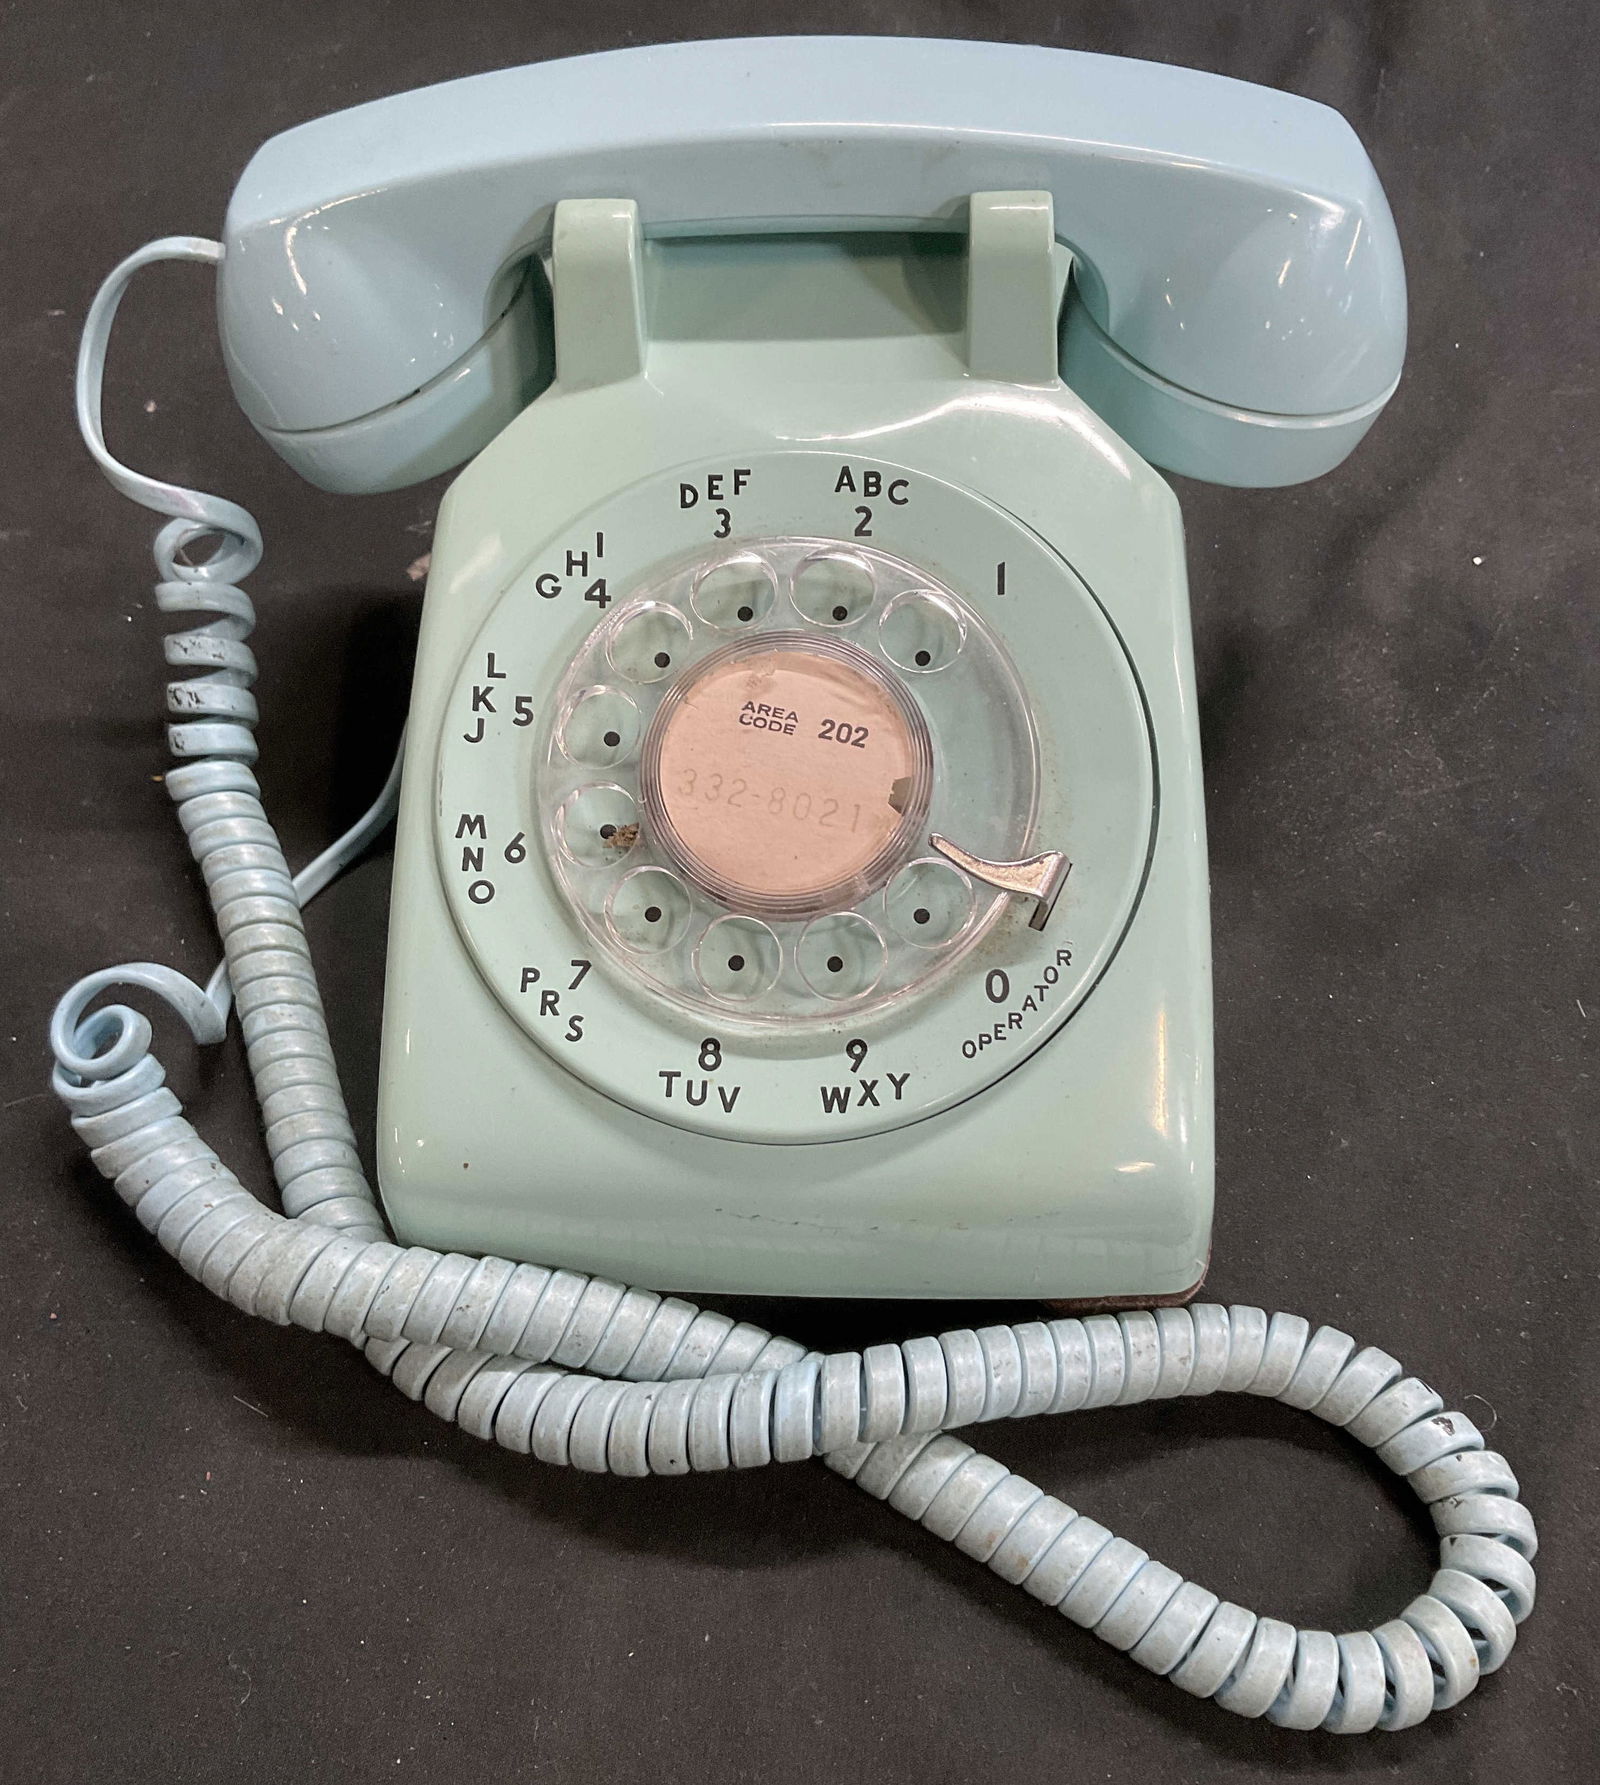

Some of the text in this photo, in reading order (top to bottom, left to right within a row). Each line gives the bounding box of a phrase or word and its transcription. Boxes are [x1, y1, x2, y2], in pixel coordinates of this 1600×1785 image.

[680, 469, 751, 509] DEF
[834, 466, 910, 505] ABC
[713, 508, 732, 538] 3
[854, 506, 873, 537] 2
[535, 532, 604, 599] GHI
[997, 561, 1005, 595] 1
[584, 578, 611, 608] 4
[512, 696, 534, 726] 5
[739, 713, 797, 735] CODE
[741, 701, 799, 723] AREA
[818, 719, 869, 748] 202
[677, 768, 861, 832] 332-8021
[504, 831, 526, 864] 6
[568, 960, 592, 990] 7
[985, 969, 1010, 1003] 0
[962, 949, 1072, 1059] OPERATOR
[698, 1037, 722, 1071] 8
[846, 1038, 868, 1073] 9
[659, 1071, 741, 1113] TUV
[820, 1073, 910, 1113] WXY
